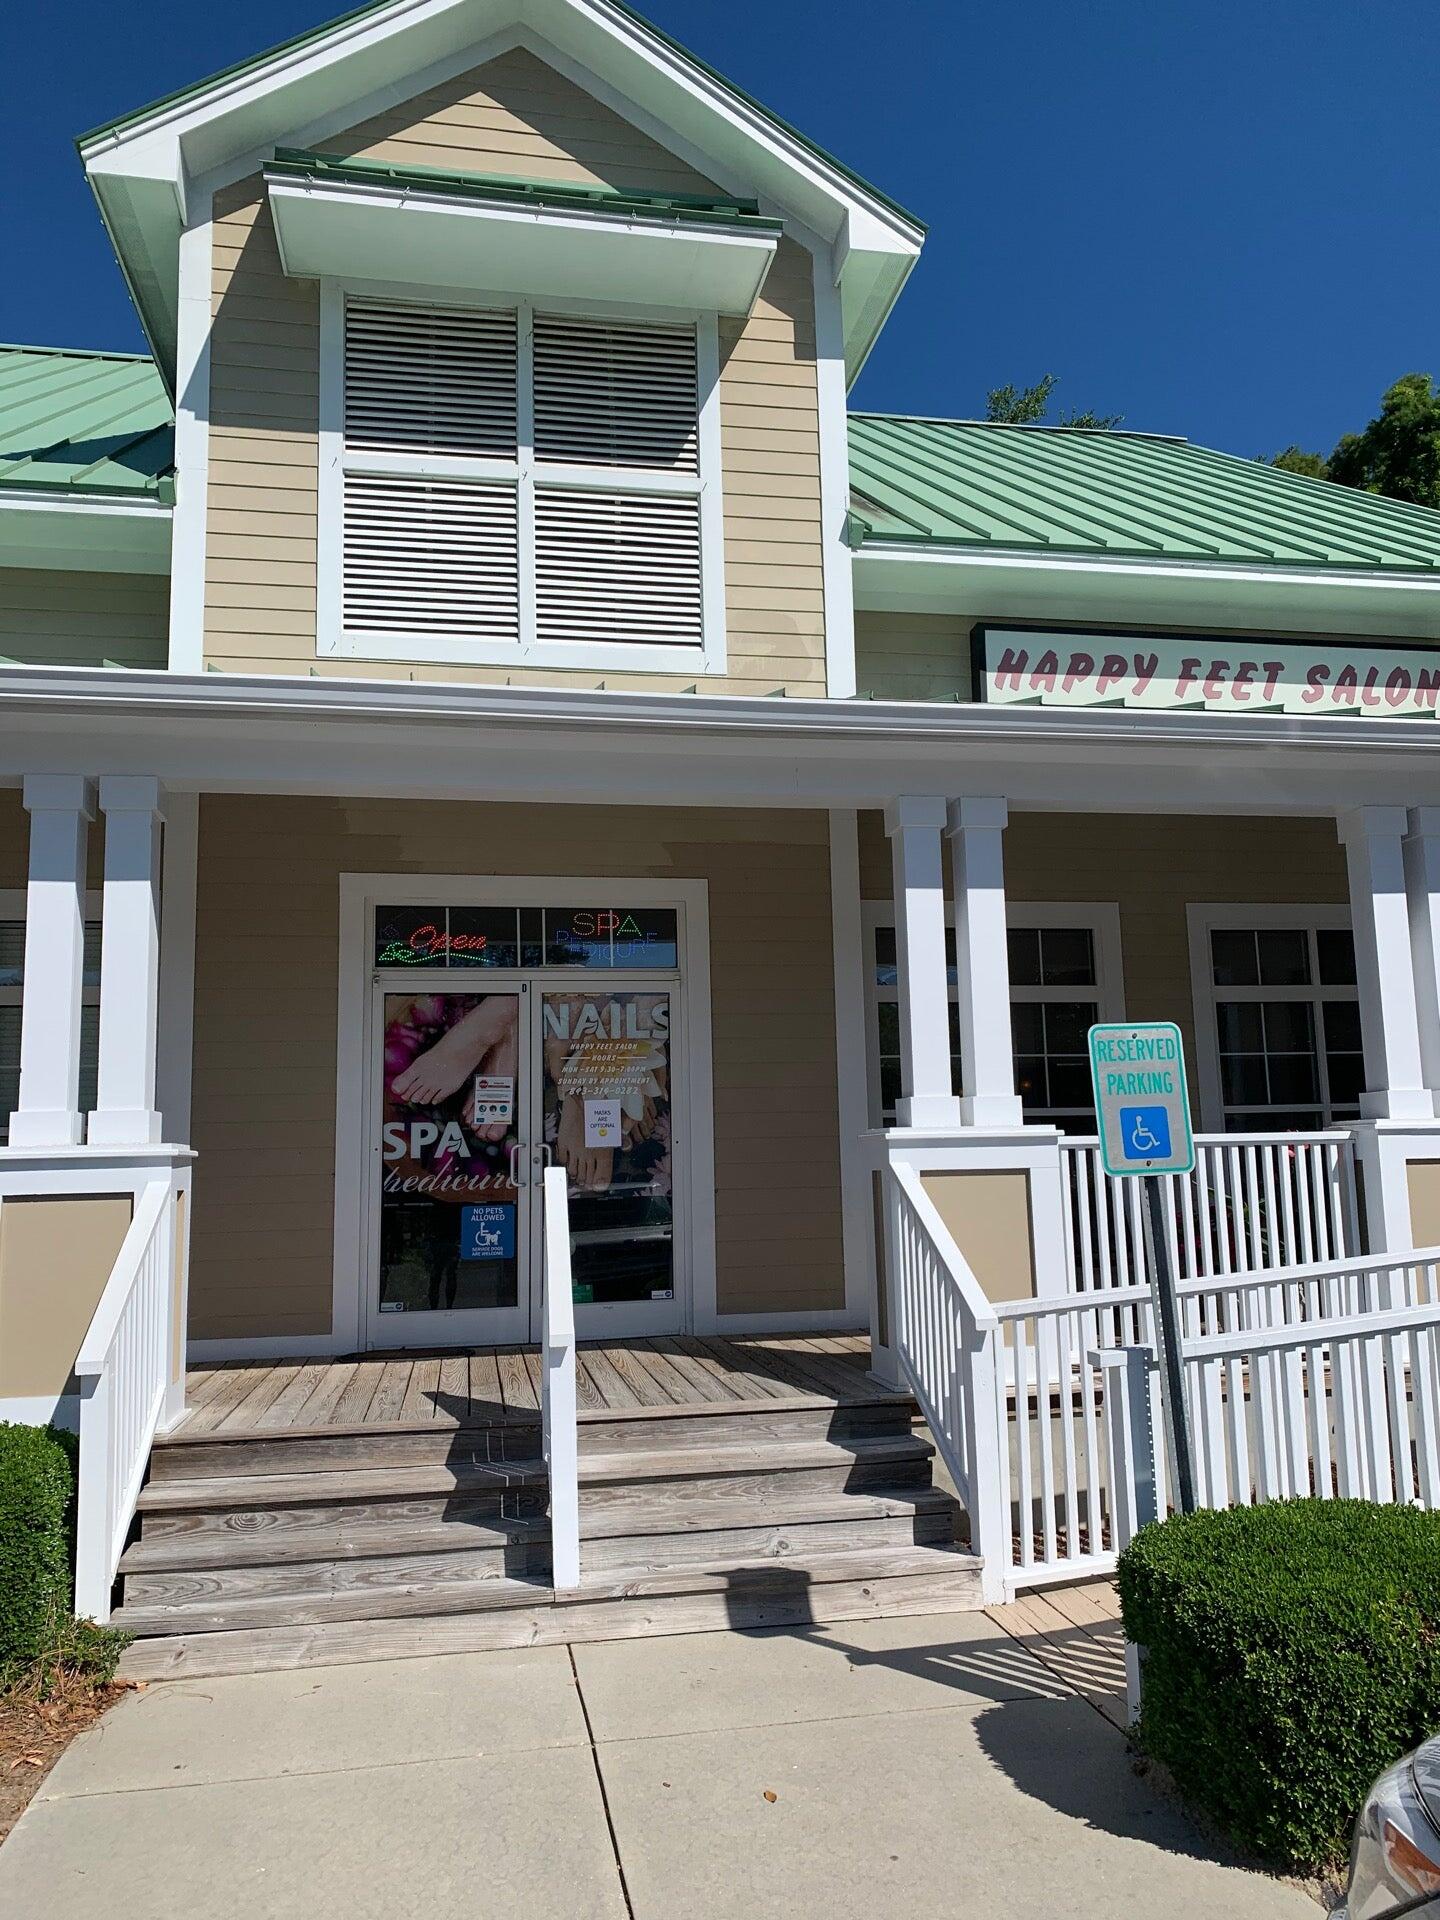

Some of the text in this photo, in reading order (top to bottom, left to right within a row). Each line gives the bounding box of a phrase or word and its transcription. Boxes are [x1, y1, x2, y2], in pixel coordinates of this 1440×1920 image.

[994, 647, 1440, 708] HAPPY FEET SALON
[572, 912, 642, 936] SPA
[409, 924, 487, 956] Open
[543, 1002, 669, 1040] NAILS
[615, 1042, 638, 1050] SALON
[1096, 1038, 1175, 1062] RESERVED
[557, 1077, 587, 1085] SUNDAY
[600, 1076, 650, 1084] APPOINTMENT
[1106, 1071, 1173, 1096] PARKING
[383, 1121, 472, 1160] SPA
[471, 1214, 506, 1222] ALLOWED
